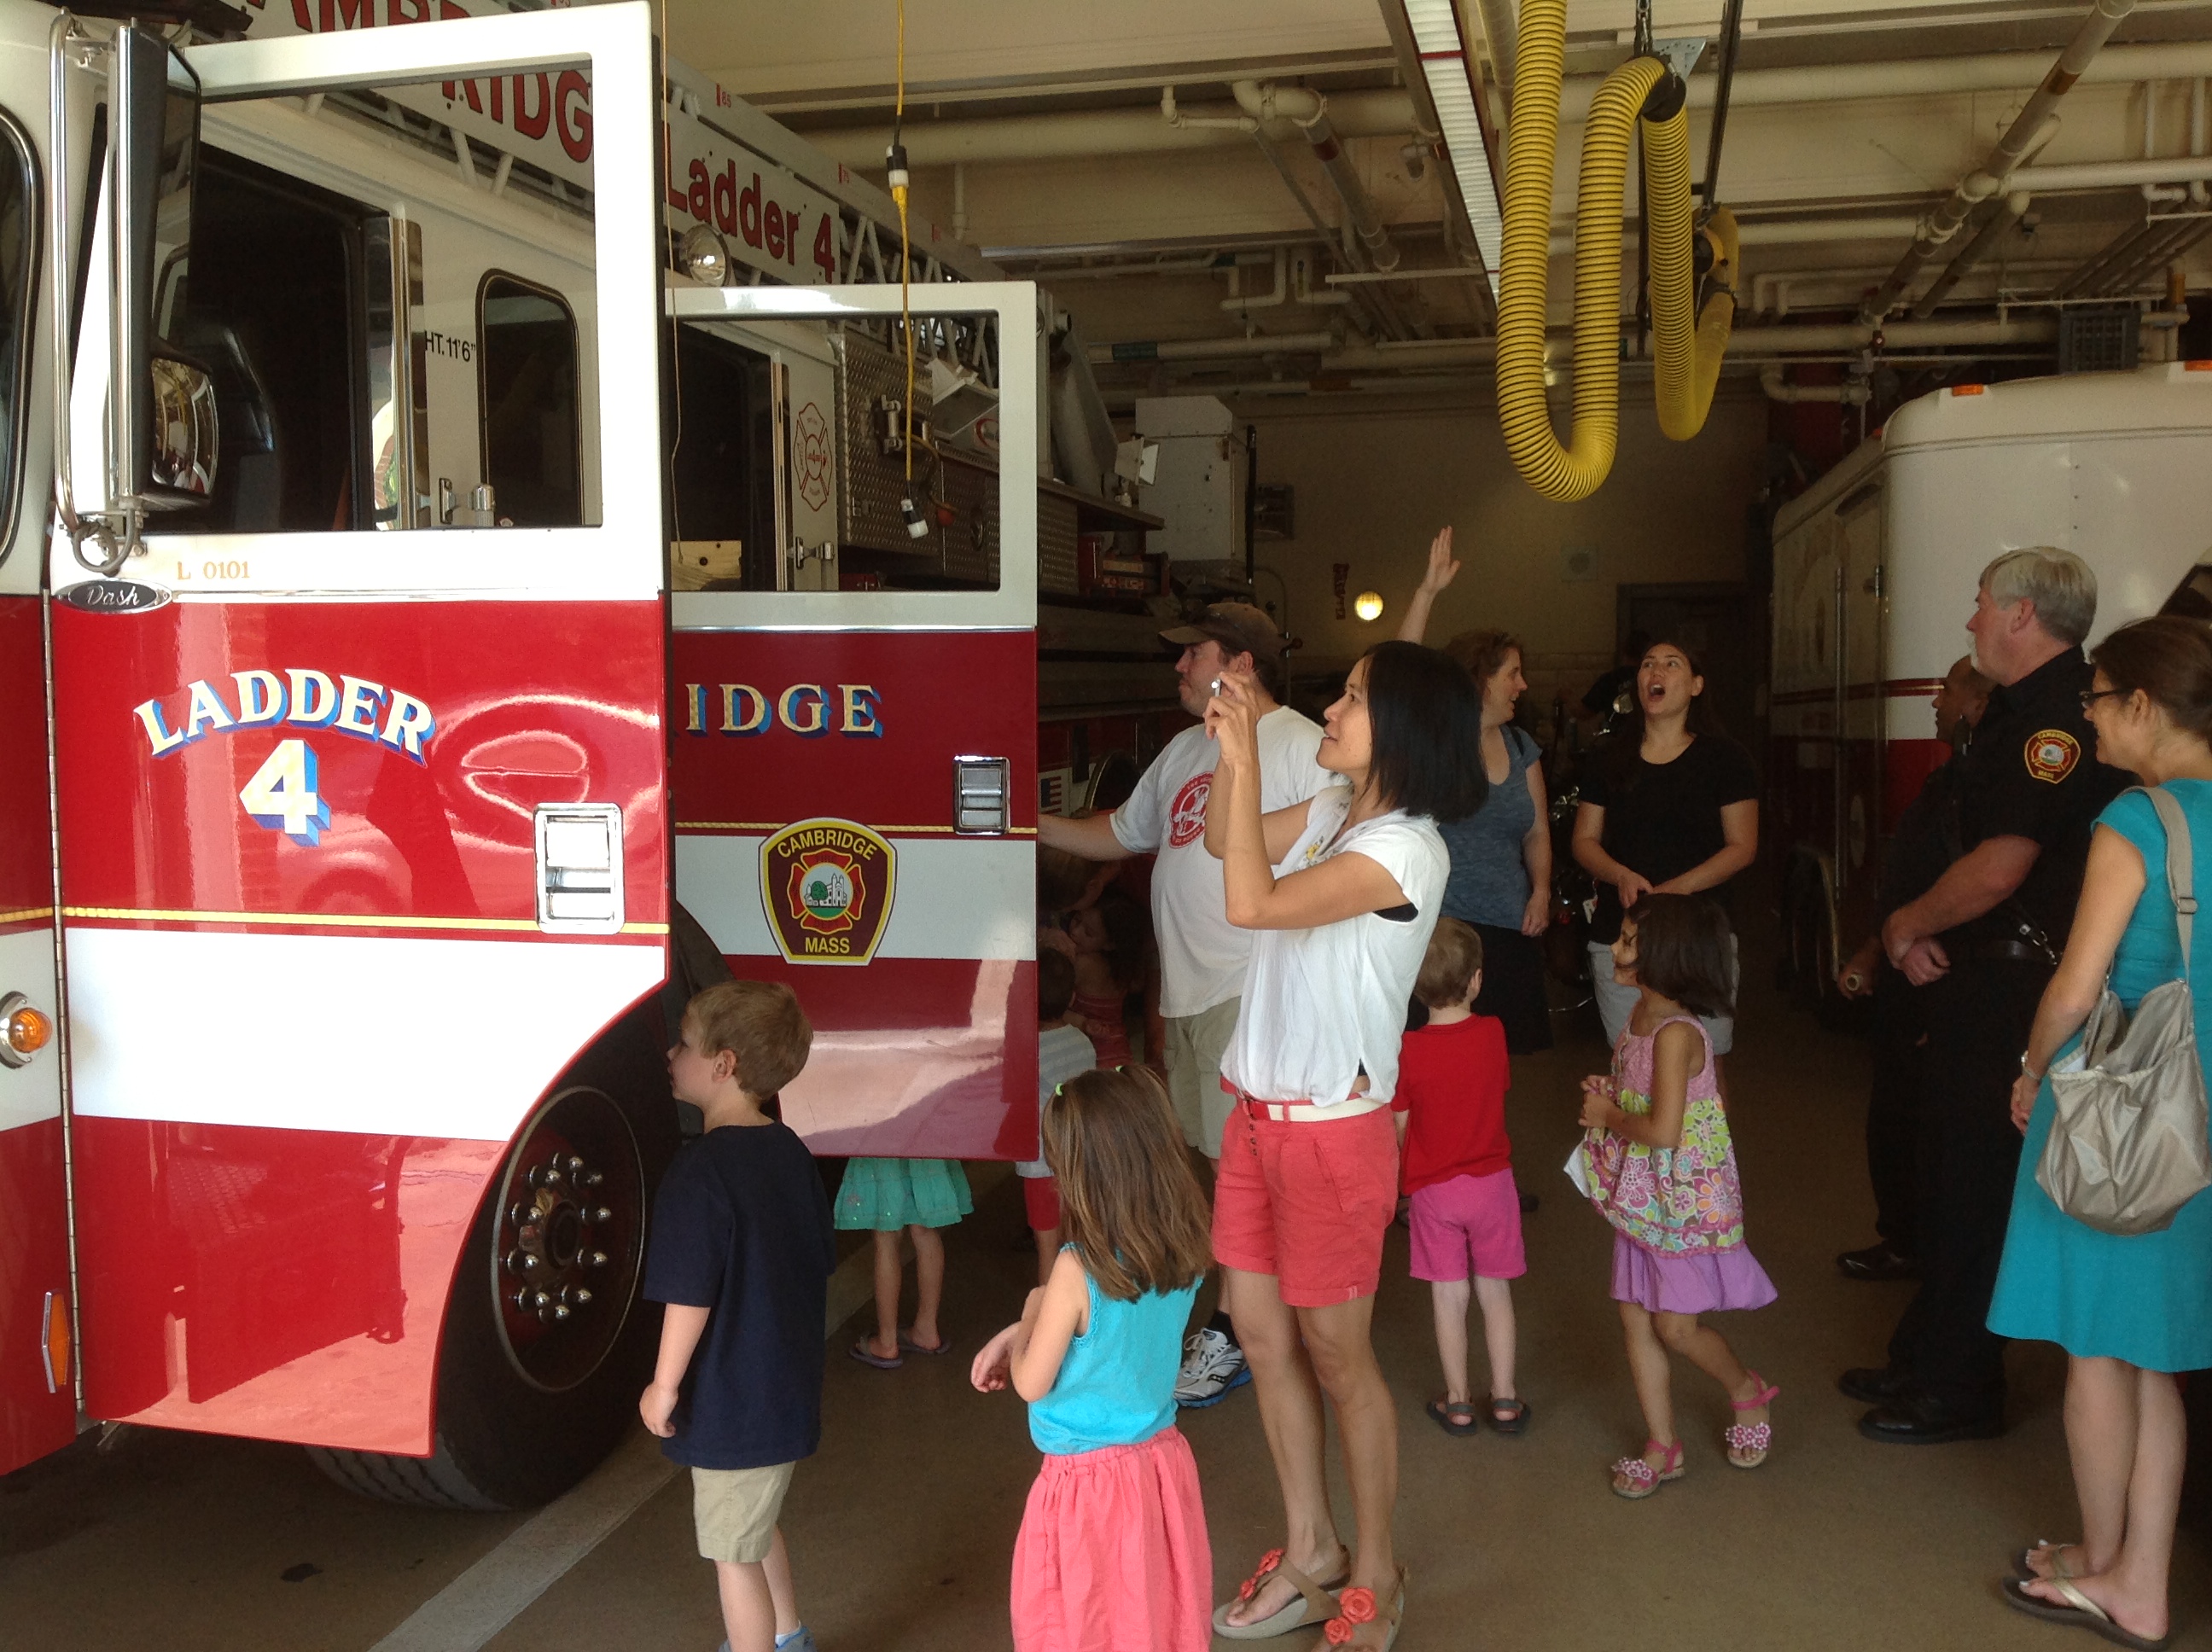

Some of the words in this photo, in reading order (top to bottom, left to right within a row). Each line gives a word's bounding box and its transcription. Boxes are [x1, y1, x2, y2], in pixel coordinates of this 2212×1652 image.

[661, 120, 799, 266] Ladder
[813, 212, 835, 284] 4
[177, 561, 191, 580] L
[203, 561, 250, 579] 0101
[84, 585, 141, 606] Dash
[133, 668, 436, 768] LADDER
[239, 739, 331, 847] 4
[777, 829, 878, 860] CAMBRIDGE
[805, 937, 850, 953] MASS
